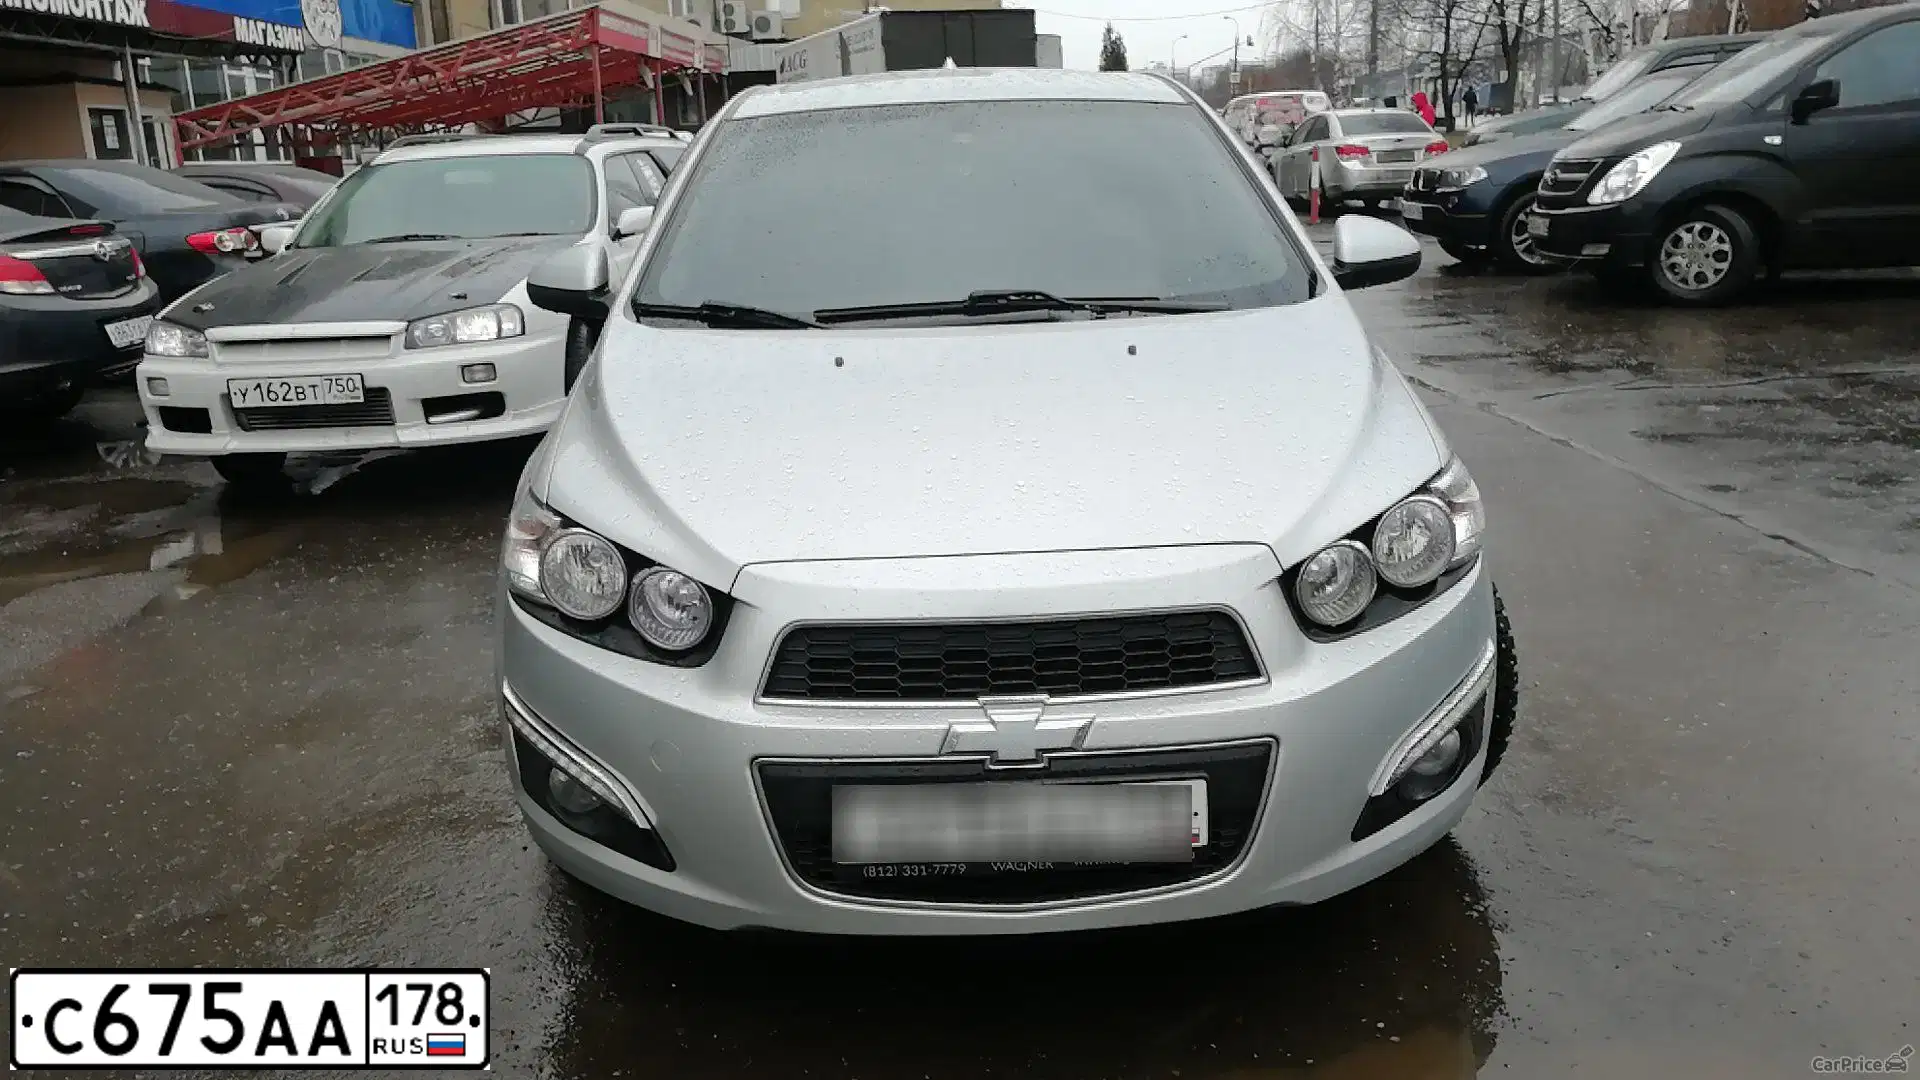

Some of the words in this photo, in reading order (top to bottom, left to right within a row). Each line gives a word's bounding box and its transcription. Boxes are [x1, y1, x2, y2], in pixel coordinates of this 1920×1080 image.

[233, 16, 304, 51] МАГАЗИН
[238, 381, 319, 404] У162ВТ
[324, 377, 356, 394] 750
[863, 865, 898, 877] (812)
[902, 863, 967, 876] 331-7779
